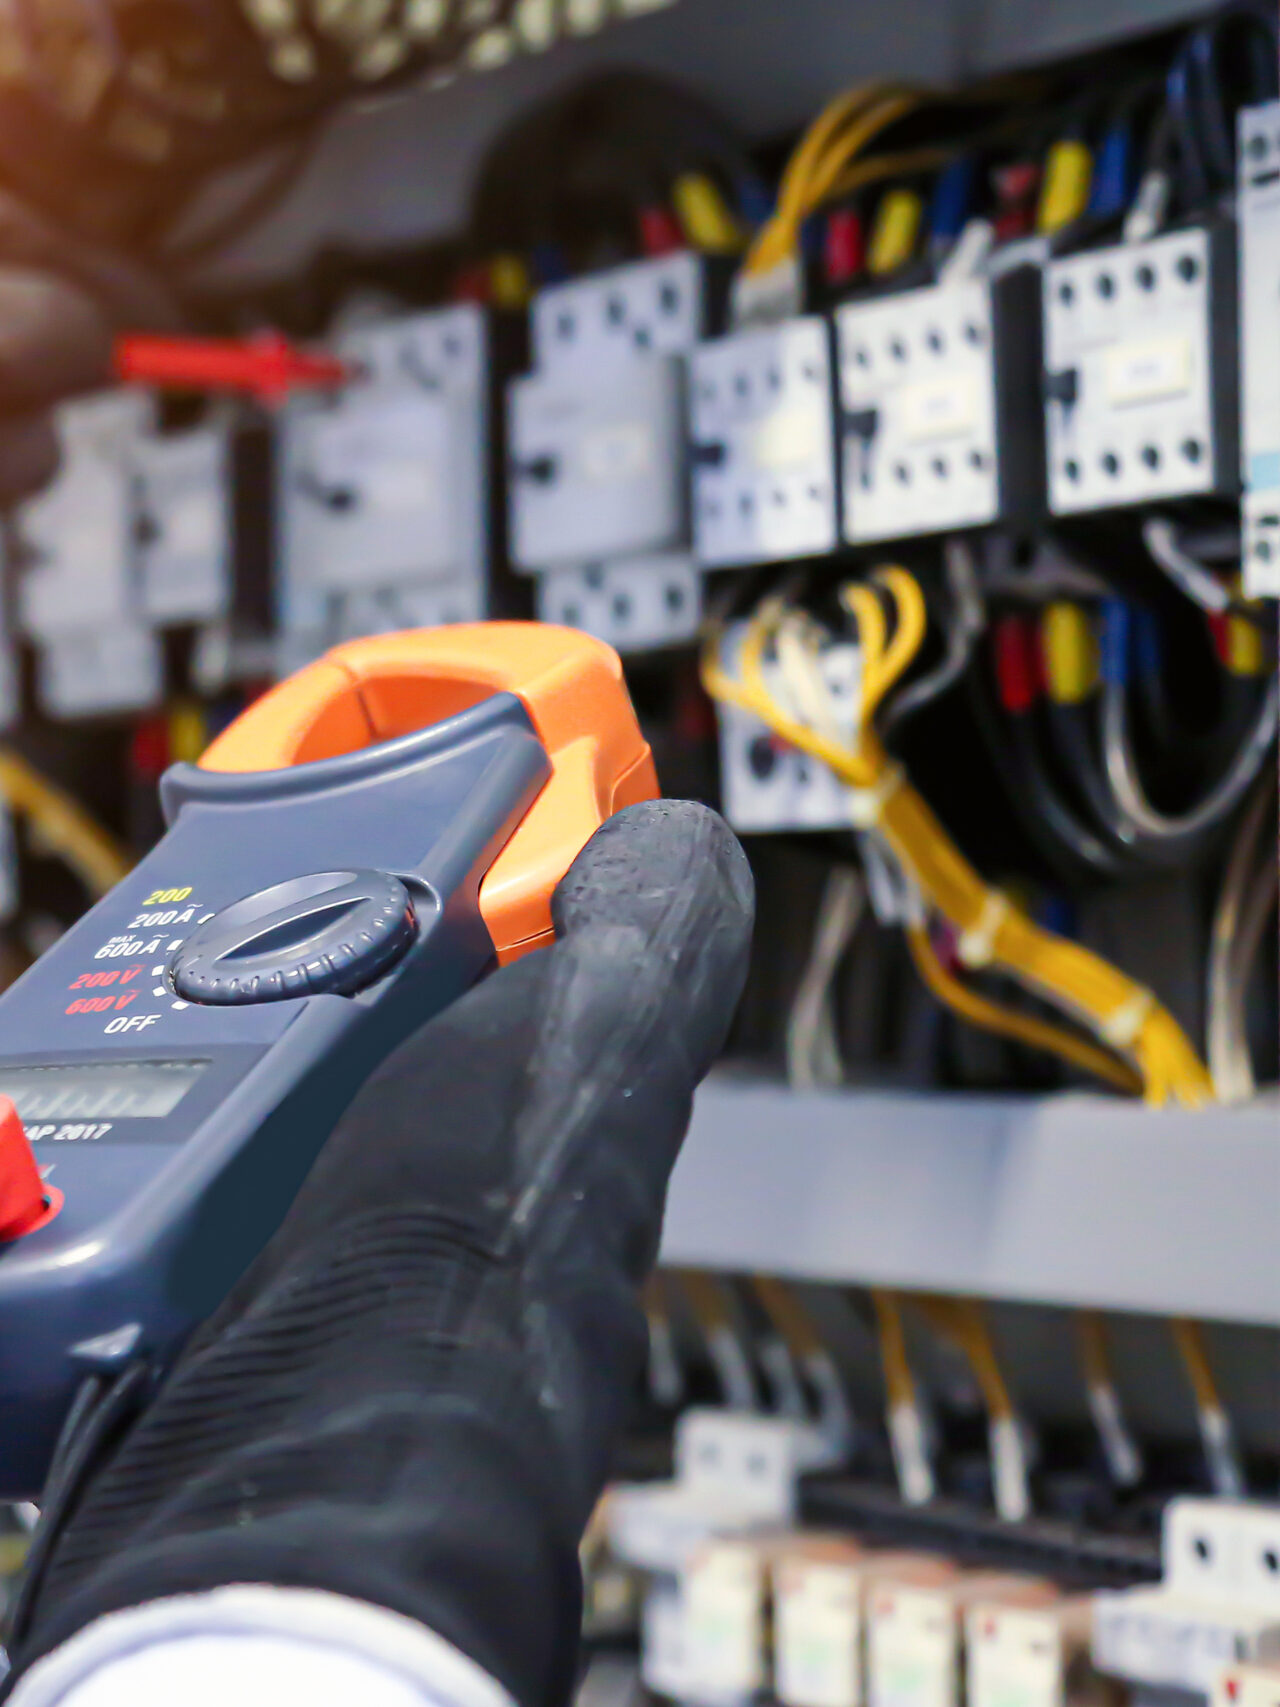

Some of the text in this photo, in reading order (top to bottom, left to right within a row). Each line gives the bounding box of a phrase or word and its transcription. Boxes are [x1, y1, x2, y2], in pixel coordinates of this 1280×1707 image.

[142, 887, 192, 905] 200
[108, 935, 136, 944] MAX
[104, 1014, 162, 1034] OFF
[23, 1123, 112, 1141] AP 2017
